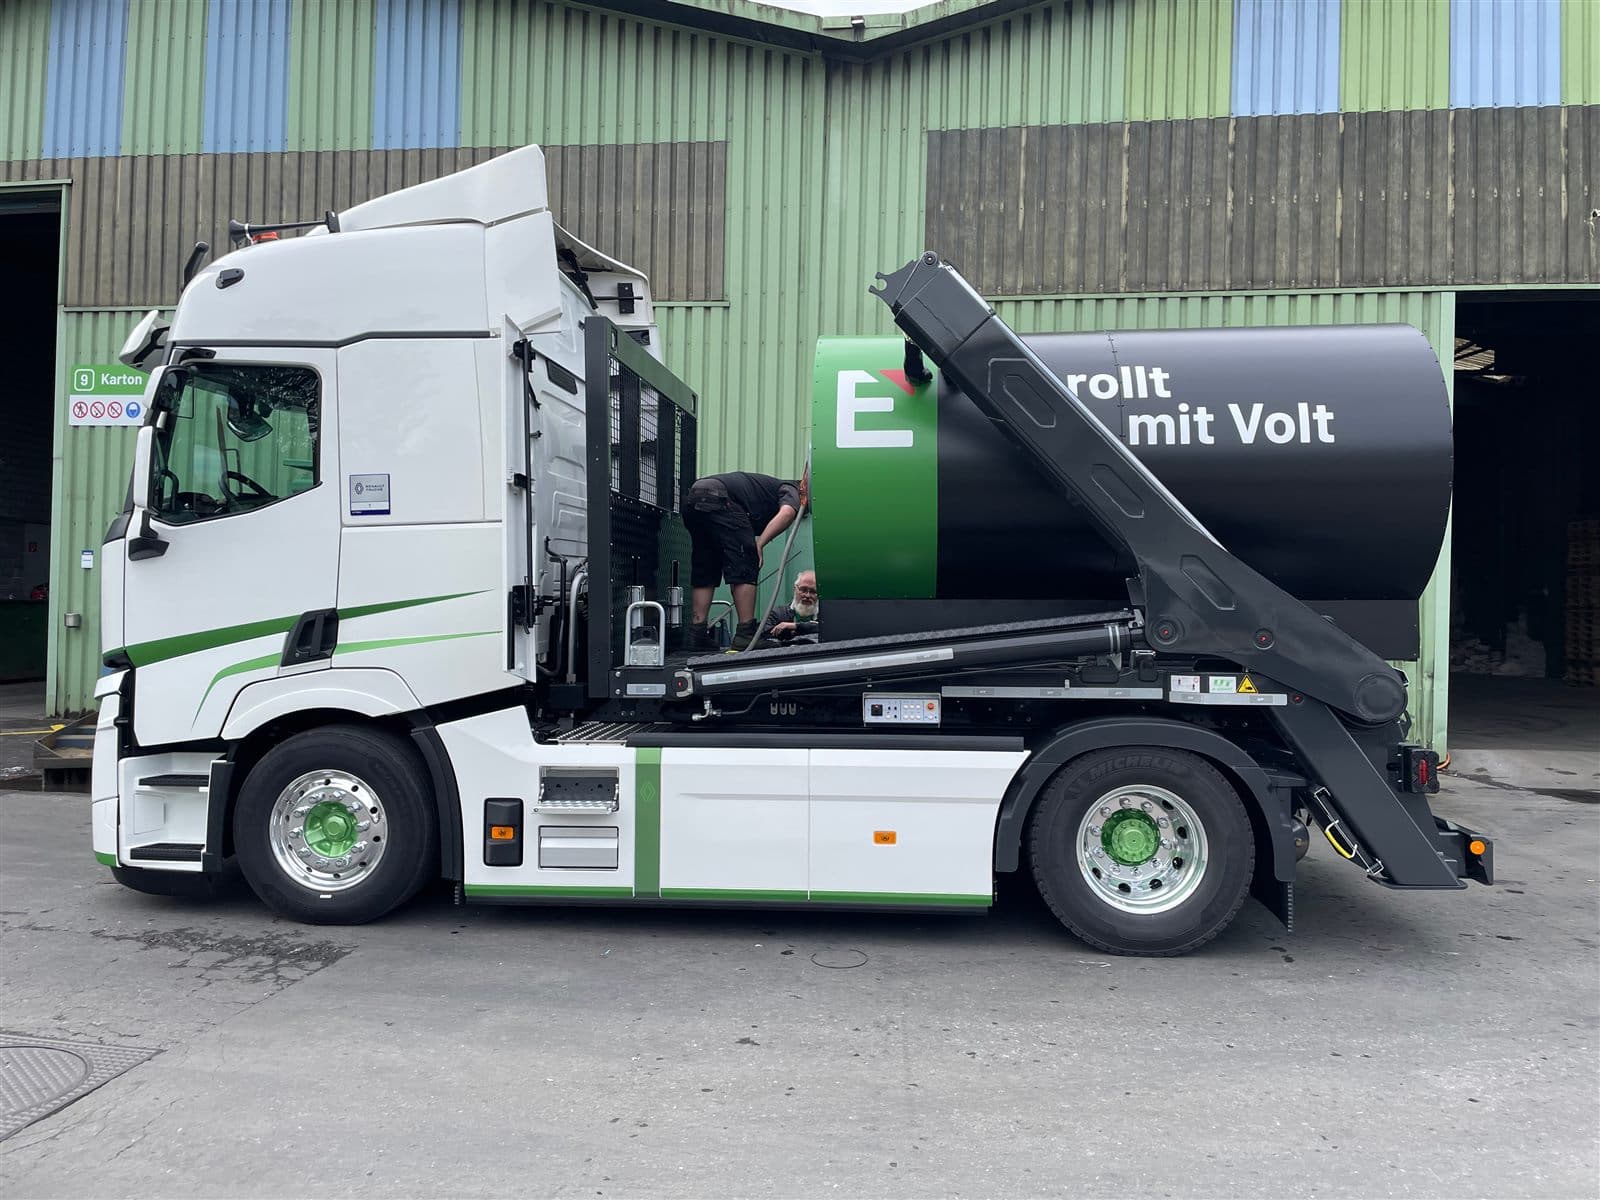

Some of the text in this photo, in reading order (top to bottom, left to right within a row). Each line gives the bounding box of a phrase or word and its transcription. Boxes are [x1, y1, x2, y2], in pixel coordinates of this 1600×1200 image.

[80, 373, 143, 386] 9 Karton
[1066, 366, 1171, 399] rollt
[836, 370, 914, 448] E
[1128, 402, 1335, 445] mit Volt
